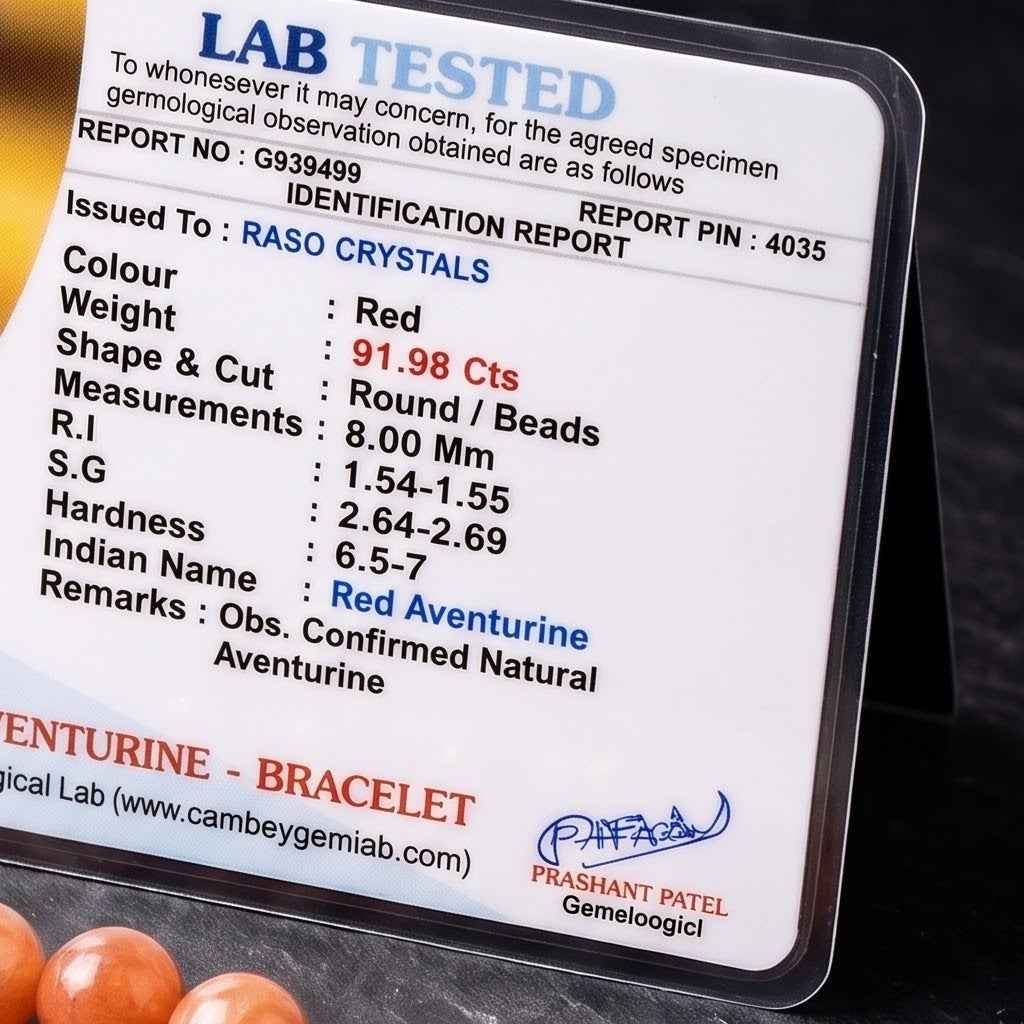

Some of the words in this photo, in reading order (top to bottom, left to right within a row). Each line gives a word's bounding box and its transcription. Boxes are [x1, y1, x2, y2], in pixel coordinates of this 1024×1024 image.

[198, 11, 327, 74] LAB
[351, 35, 616, 121] TESTED
[78, 118, 185, 154] REPORT
[193, 138, 230, 162] NO
[254, 148, 361, 183] G939499
[107, 86, 256, 125] germological
[264, 112, 400, 149] observation
[408, 133, 511, 166] obtained
[520, 152, 558, 173] are
[566, 160, 594, 179] as
[602, 162, 684, 195] follows
[110, 51, 138, 74] To
[145, 59, 289, 100] whonesever
[297, 81, 308, 104] it
[318, 88, 367, 118] may
[375, 99, 477, 133] concern,
[486, 113, 518, 136] for
[525, 118, 561, 144] the
[569, 132, 654, 160] agreed
[662, 142, 779, 181] specimen
[67, 189, 166, 231] Issued
[177, 208, 212, 238] To
[242, 220, 325, 256] RASO
[335, 236, 490, 284] CRYSTALS
[287, 182, 505, 239] IDENTIFICATION
[514, 220, 631, 259] REPORT
[578, 201, 690, 239] REPORT
[698, 220, 742, 247] PIN
[765, 234, 827, 262] 4035
[63, 245, 178, 289] Colour
[356, 296, 422, 333] Red
[60, 285, 176, 332] Weight
[352, 338, 450, 380] 91.98
[464, 356, 520, 392] Cts
[54, 368, 303, 437] Measurements
[346, 420, 422, 457] 8.00
[433, 434, 494, 471] Mm
[57, 327, 163, 372] Shape
[176, 348, 200, 378] &
[215, 355, 275, 390] Cut
[350, 378, 460, 423] Round
[470, 399, 484, 426] /
[494, 402, 600, 446] Beads
[48, 449, 106, 483] S.G
[338, 501, 507, 555] 2.64-2.69
[51, 408, 95, 441] R.I
[344, 460, 510, 514] 1.54-1.55
[46, 488, 206, 542] Hardness
[335, 540, 427, 580] 6.5-7
[40, 568, 186, 620] Remarks
[219, 602, 290, 638] Obs.
[302, 617, 470, 670] Confirmed
[480, 647, 598, 693] Natural
[43, 528, 147, 573] Indian
[161, 550, 257, 592] Name
[331, 580, 394, 617] Red
[404, 594, 589, 650] Aventurine
[214, 641, 385, 695] Aventurine
[59, 776, 105, 807] Lab
[256, 757, 477, 826] BRACELET
[531, 864, 653, 902] PRASHANT
[659, 888, 729, 916] PATEL
[562, 895, 703, 938] Gemeloogicl
